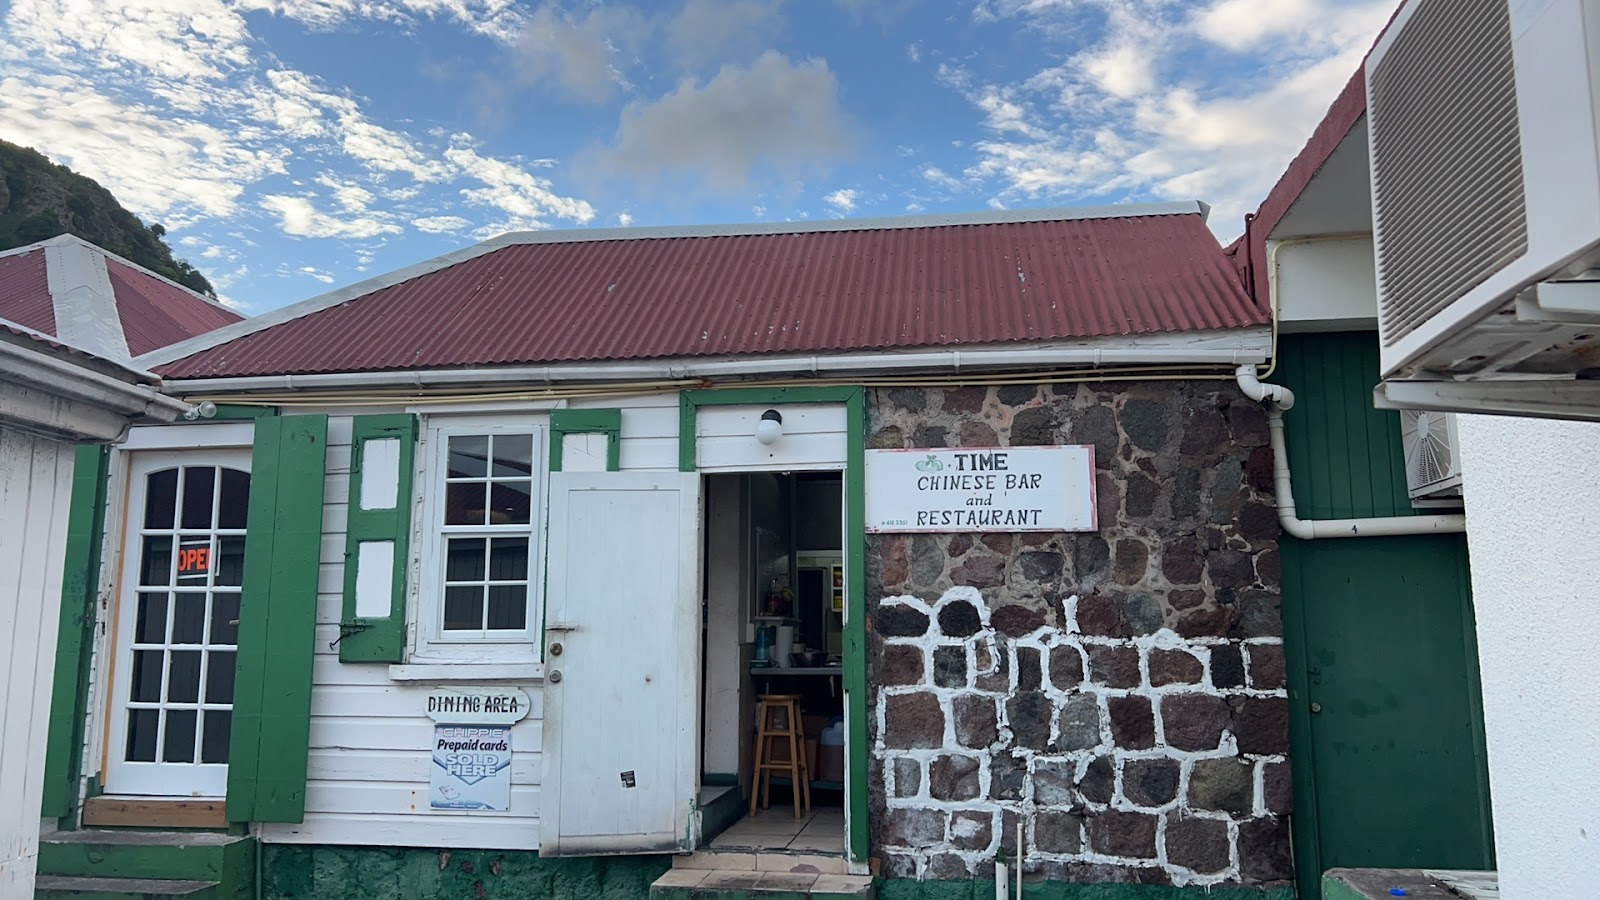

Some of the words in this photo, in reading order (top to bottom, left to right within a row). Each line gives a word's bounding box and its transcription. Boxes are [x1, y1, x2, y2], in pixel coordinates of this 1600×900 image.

[954, 453, 1008, 471] TIME
[917, 475, 997, 490] CHINESE
[1005, 474, 1042, 489] BAR
[966, 494, 992, 506] and
[917, 510, 1042, 526] RESTAURANT
[428, 697, 480, 712] DINING
[484, 696, 517, 713] AREA
[443, 728, 503, 737] CHIPPIE
[437, 739, 479, 752] Prepaid
[480, 739, 508, 751] cards
[446, 754, 498, 765] SOLD
[447, 764, 496, 776] HERE
